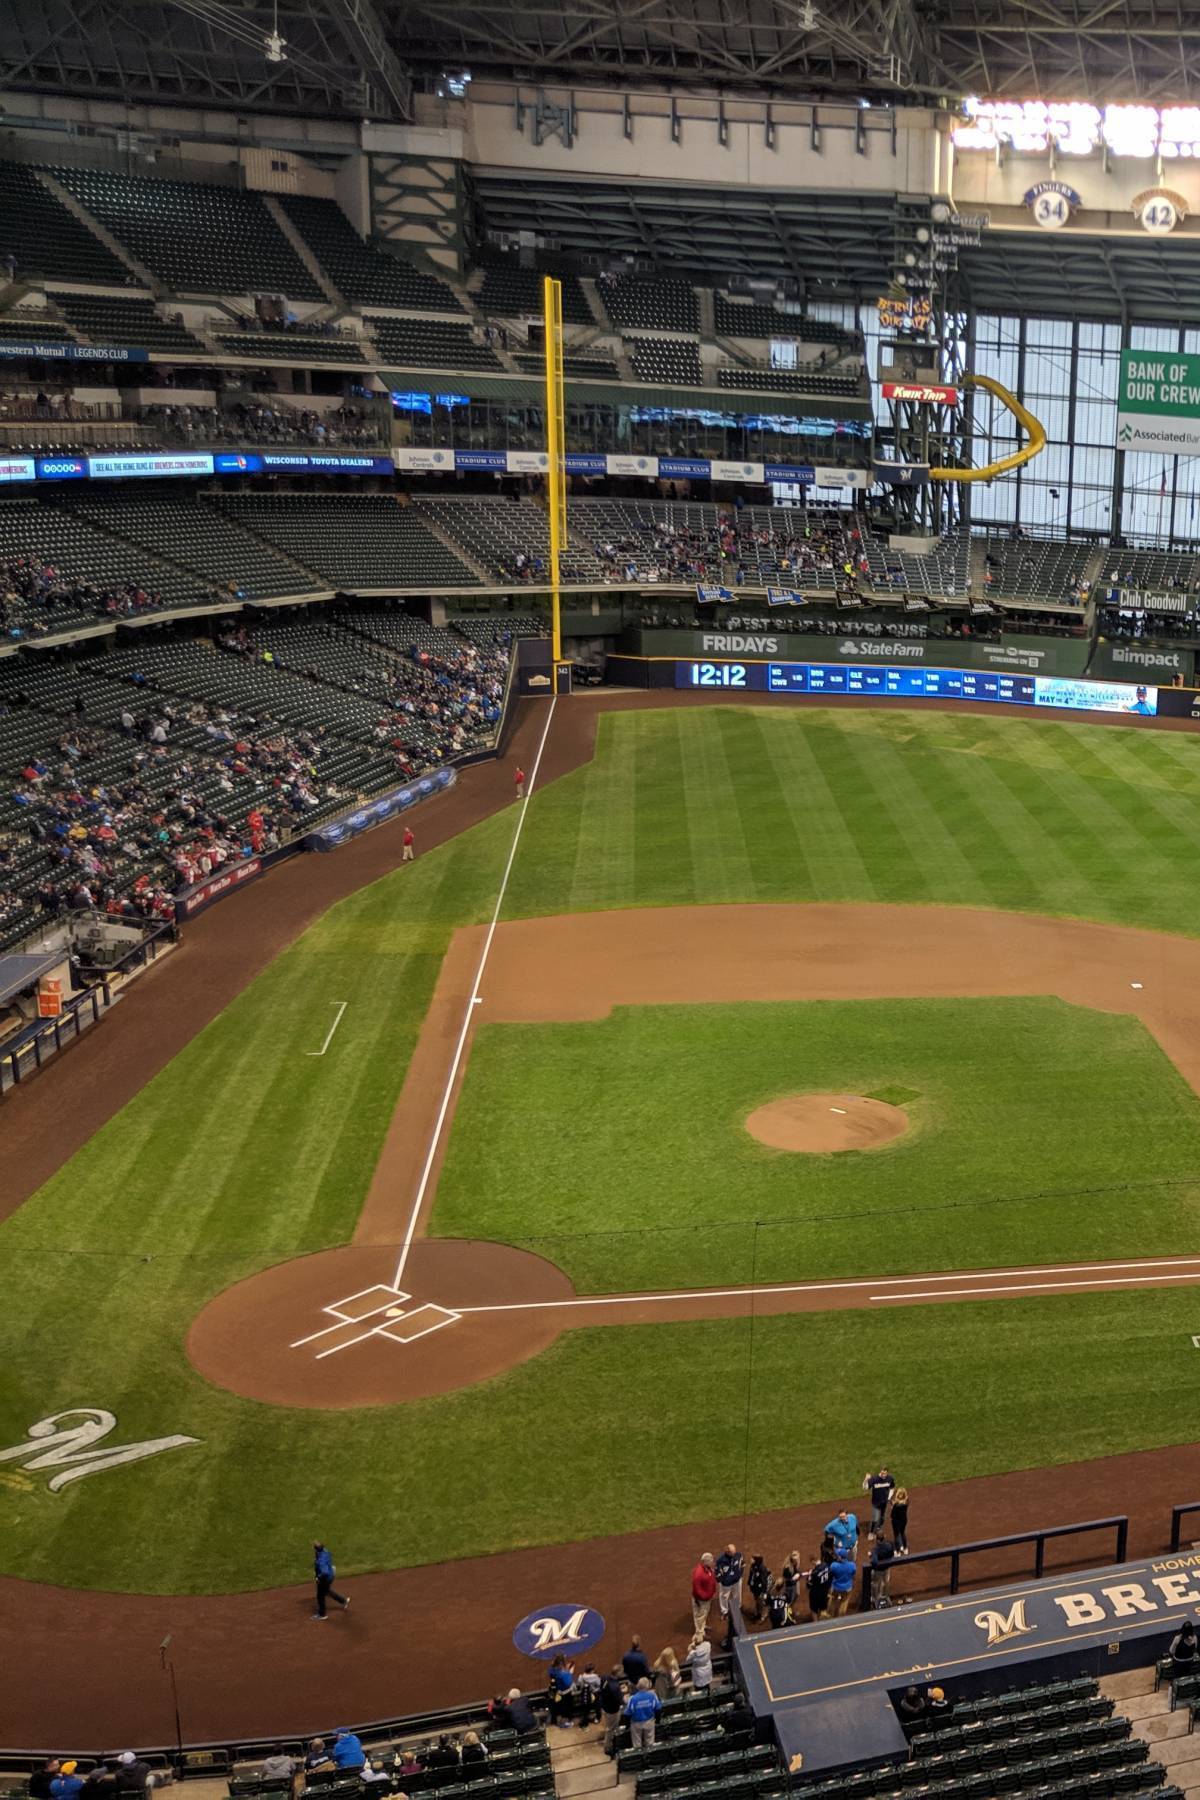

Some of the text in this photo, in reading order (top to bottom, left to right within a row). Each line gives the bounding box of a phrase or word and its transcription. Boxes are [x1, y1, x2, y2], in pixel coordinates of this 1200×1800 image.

[1033, 182, 1072, 197] FINGERS
[1038, 199, 1064, 220] 34
[1145, 205, 1171, 226] 42
[36, 345, 128, 359] Mutual LEGENDS CLUB
[1127, 361, 1188, 382] BANK OF
[1127, 382, 1155, 401] OUR
[264, 456, 373, 466] WISCONSIN TOYOTA DEALERS!
[660, 464, 710, 473] STADIUM CLUB
[1120, 589, 1187, 611] Club Goodwill
[703, 635, 778, 653] FRIDAYS
[1125, 647, 1179, 667] impact
[692, 663, 746, 686] 12:12
[1039, 696, 1055, 704] MAY
[773, 1599, 785, 1609] 19
